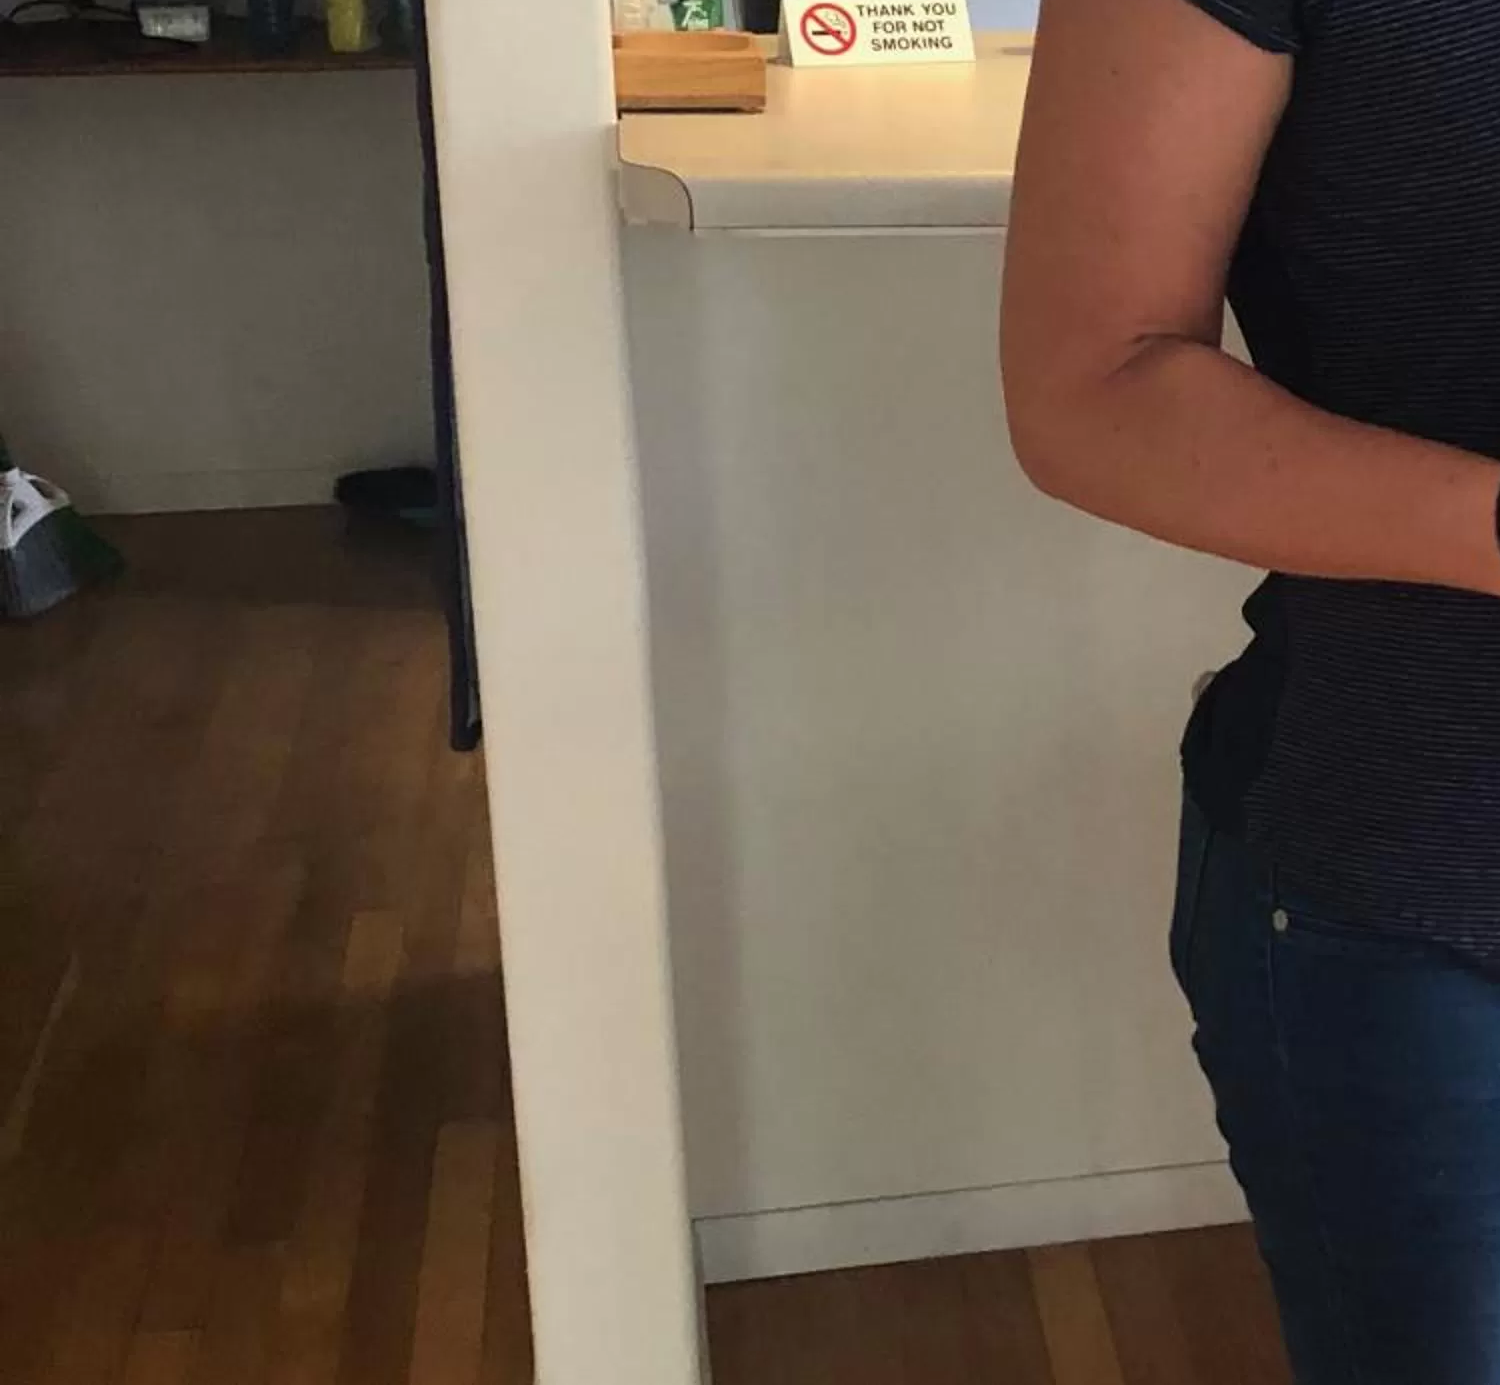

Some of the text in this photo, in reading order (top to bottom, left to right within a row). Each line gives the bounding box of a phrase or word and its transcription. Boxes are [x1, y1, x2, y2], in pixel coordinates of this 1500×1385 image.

[856, 2, 957, 17] THANK YOU
[873, 19, 945, 34] FOR NOT
[870, 36, 953, 52] SMOKING
